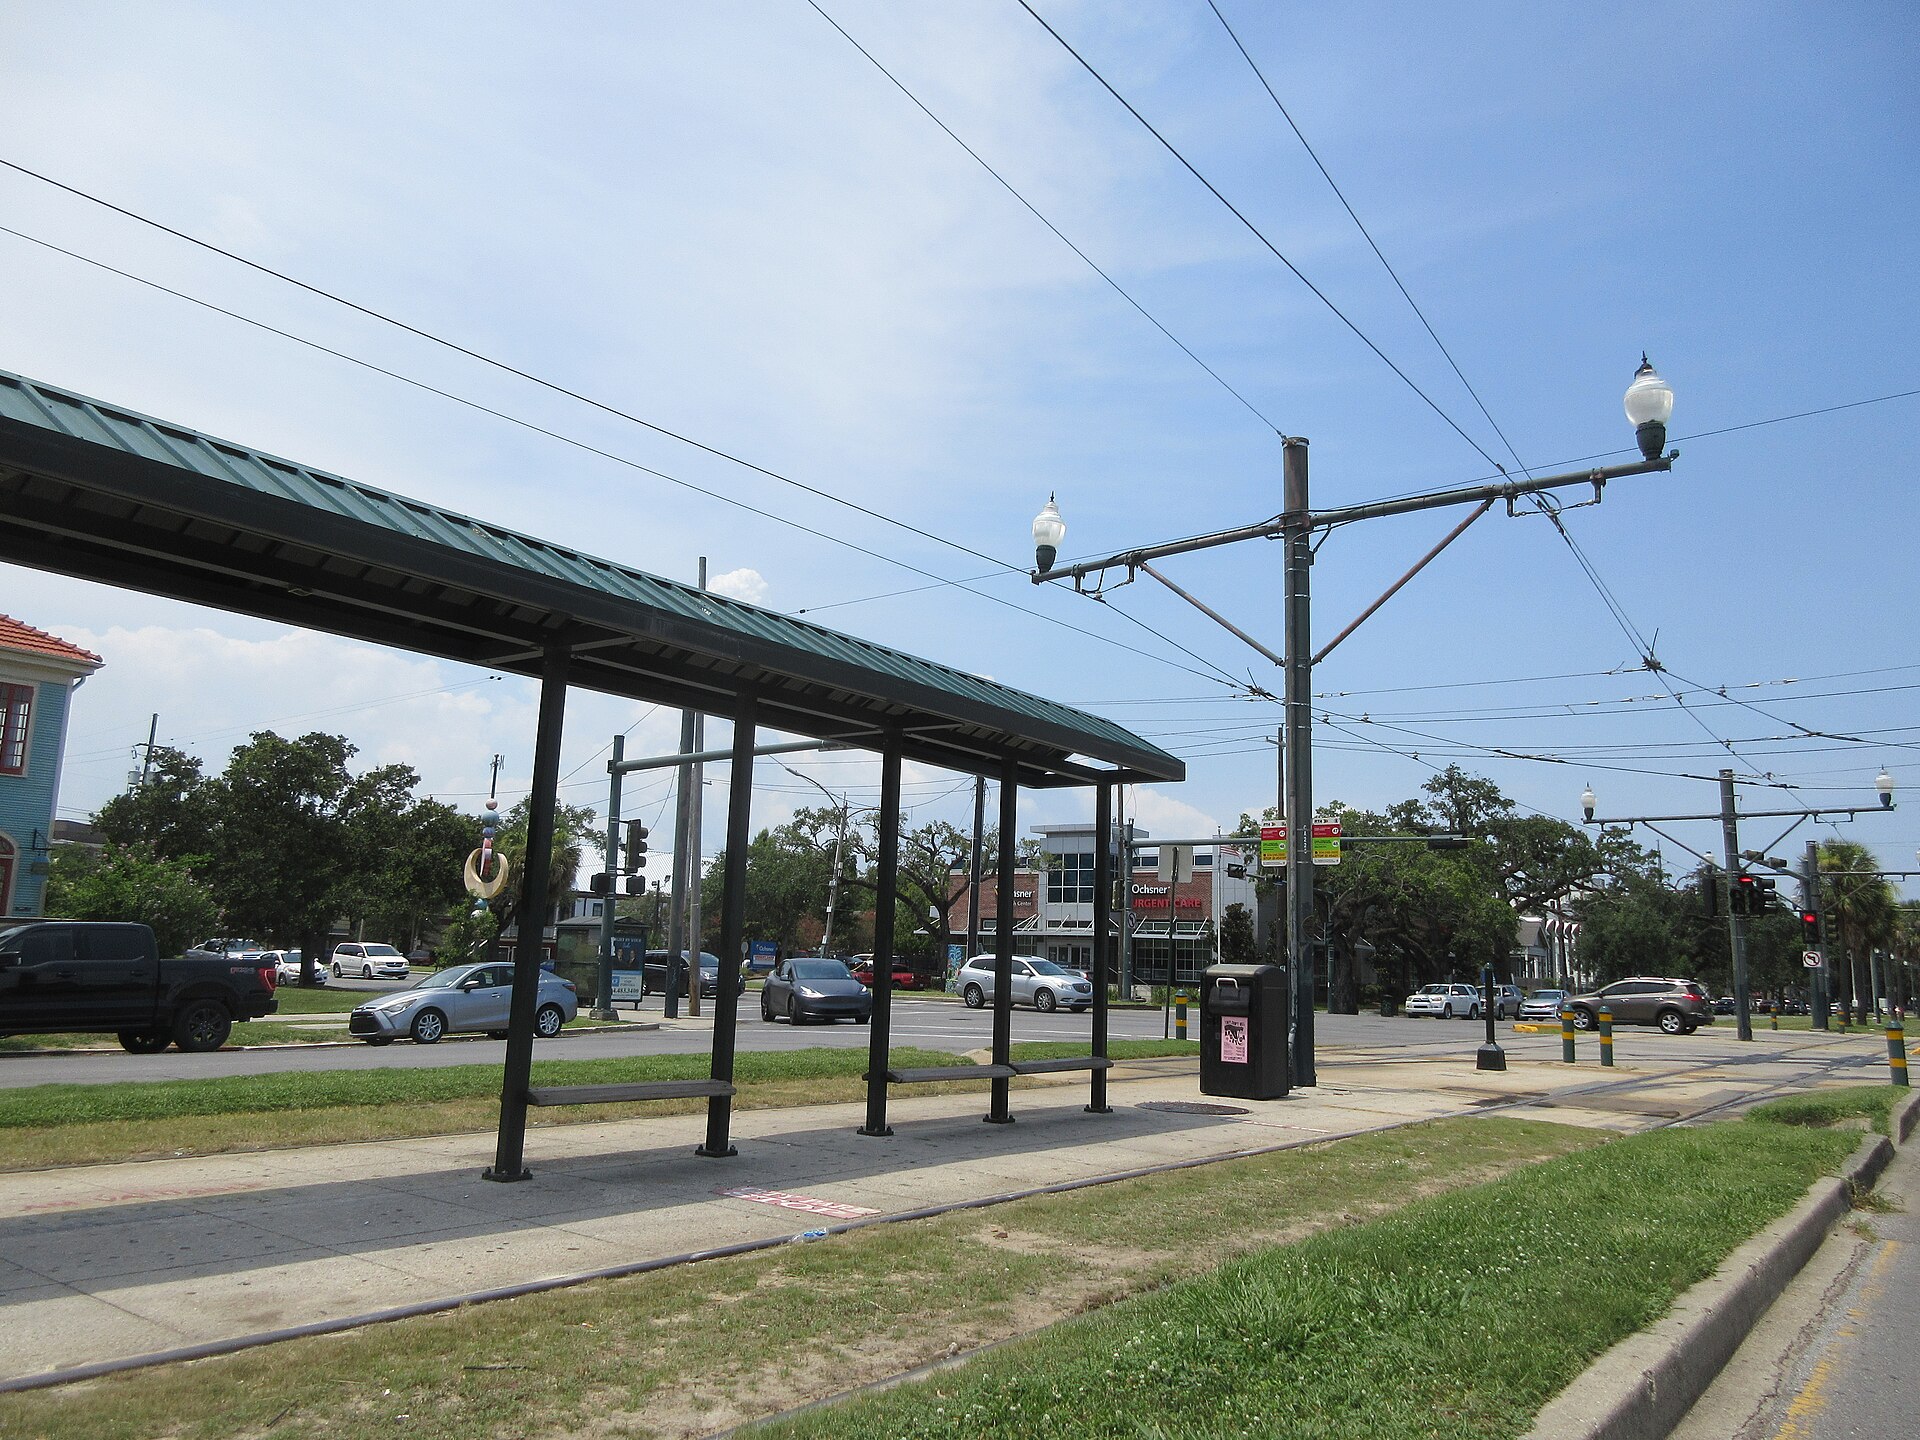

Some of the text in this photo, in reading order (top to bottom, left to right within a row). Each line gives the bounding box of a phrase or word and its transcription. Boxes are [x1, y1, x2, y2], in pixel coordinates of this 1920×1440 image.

[1131, 884, 1168, 894] Ochsner
[1132, 899, 1201, 908] URGENT CARE
